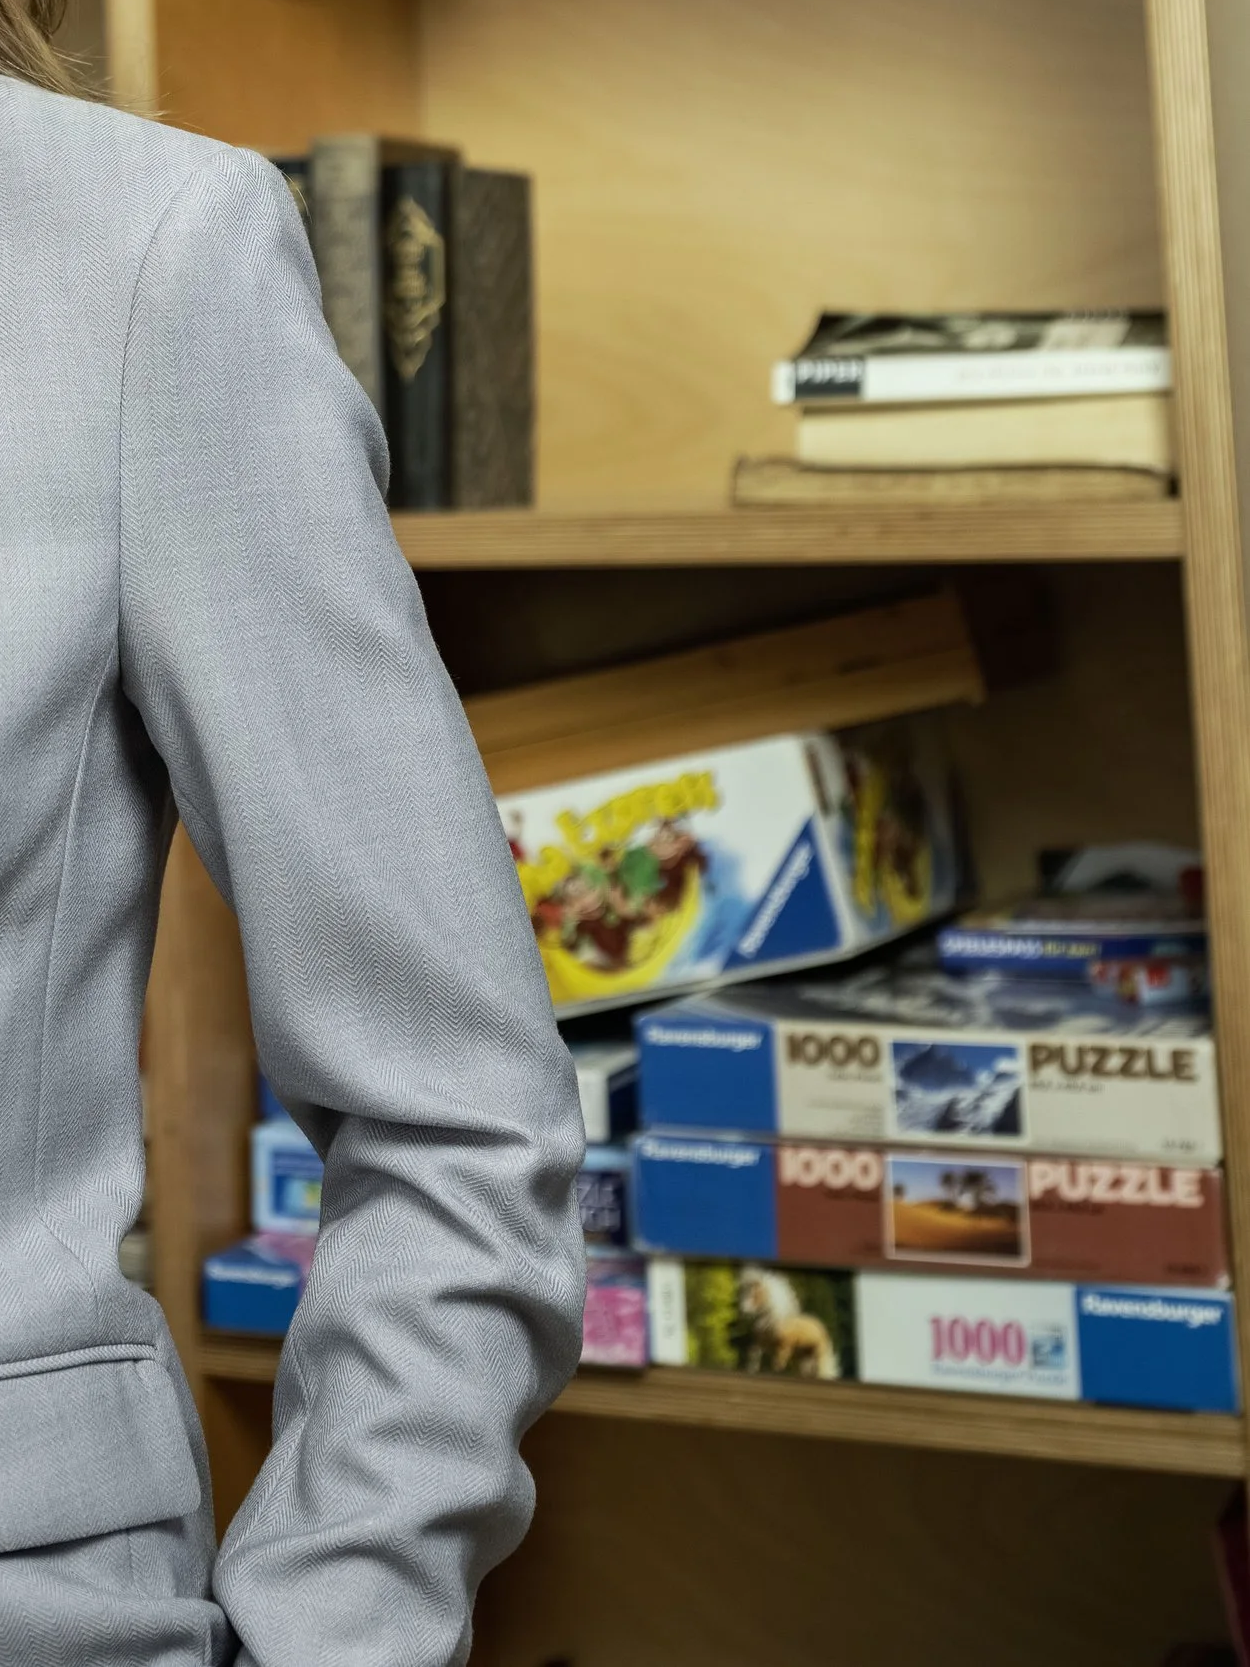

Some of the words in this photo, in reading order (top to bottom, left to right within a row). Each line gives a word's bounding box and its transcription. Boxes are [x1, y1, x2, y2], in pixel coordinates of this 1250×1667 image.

[785, 1033, 882, 1069] 1000
[1029, 1042, 1198, 1083] PUZZLE
[778, 1146, 883, 1190] 1000
[1029, 1159, 1205, 1209] PUZZLE
[1080, 1292, 1224, 1328] Ravensburger
[928, 1315, 1027, 1367] 1000
